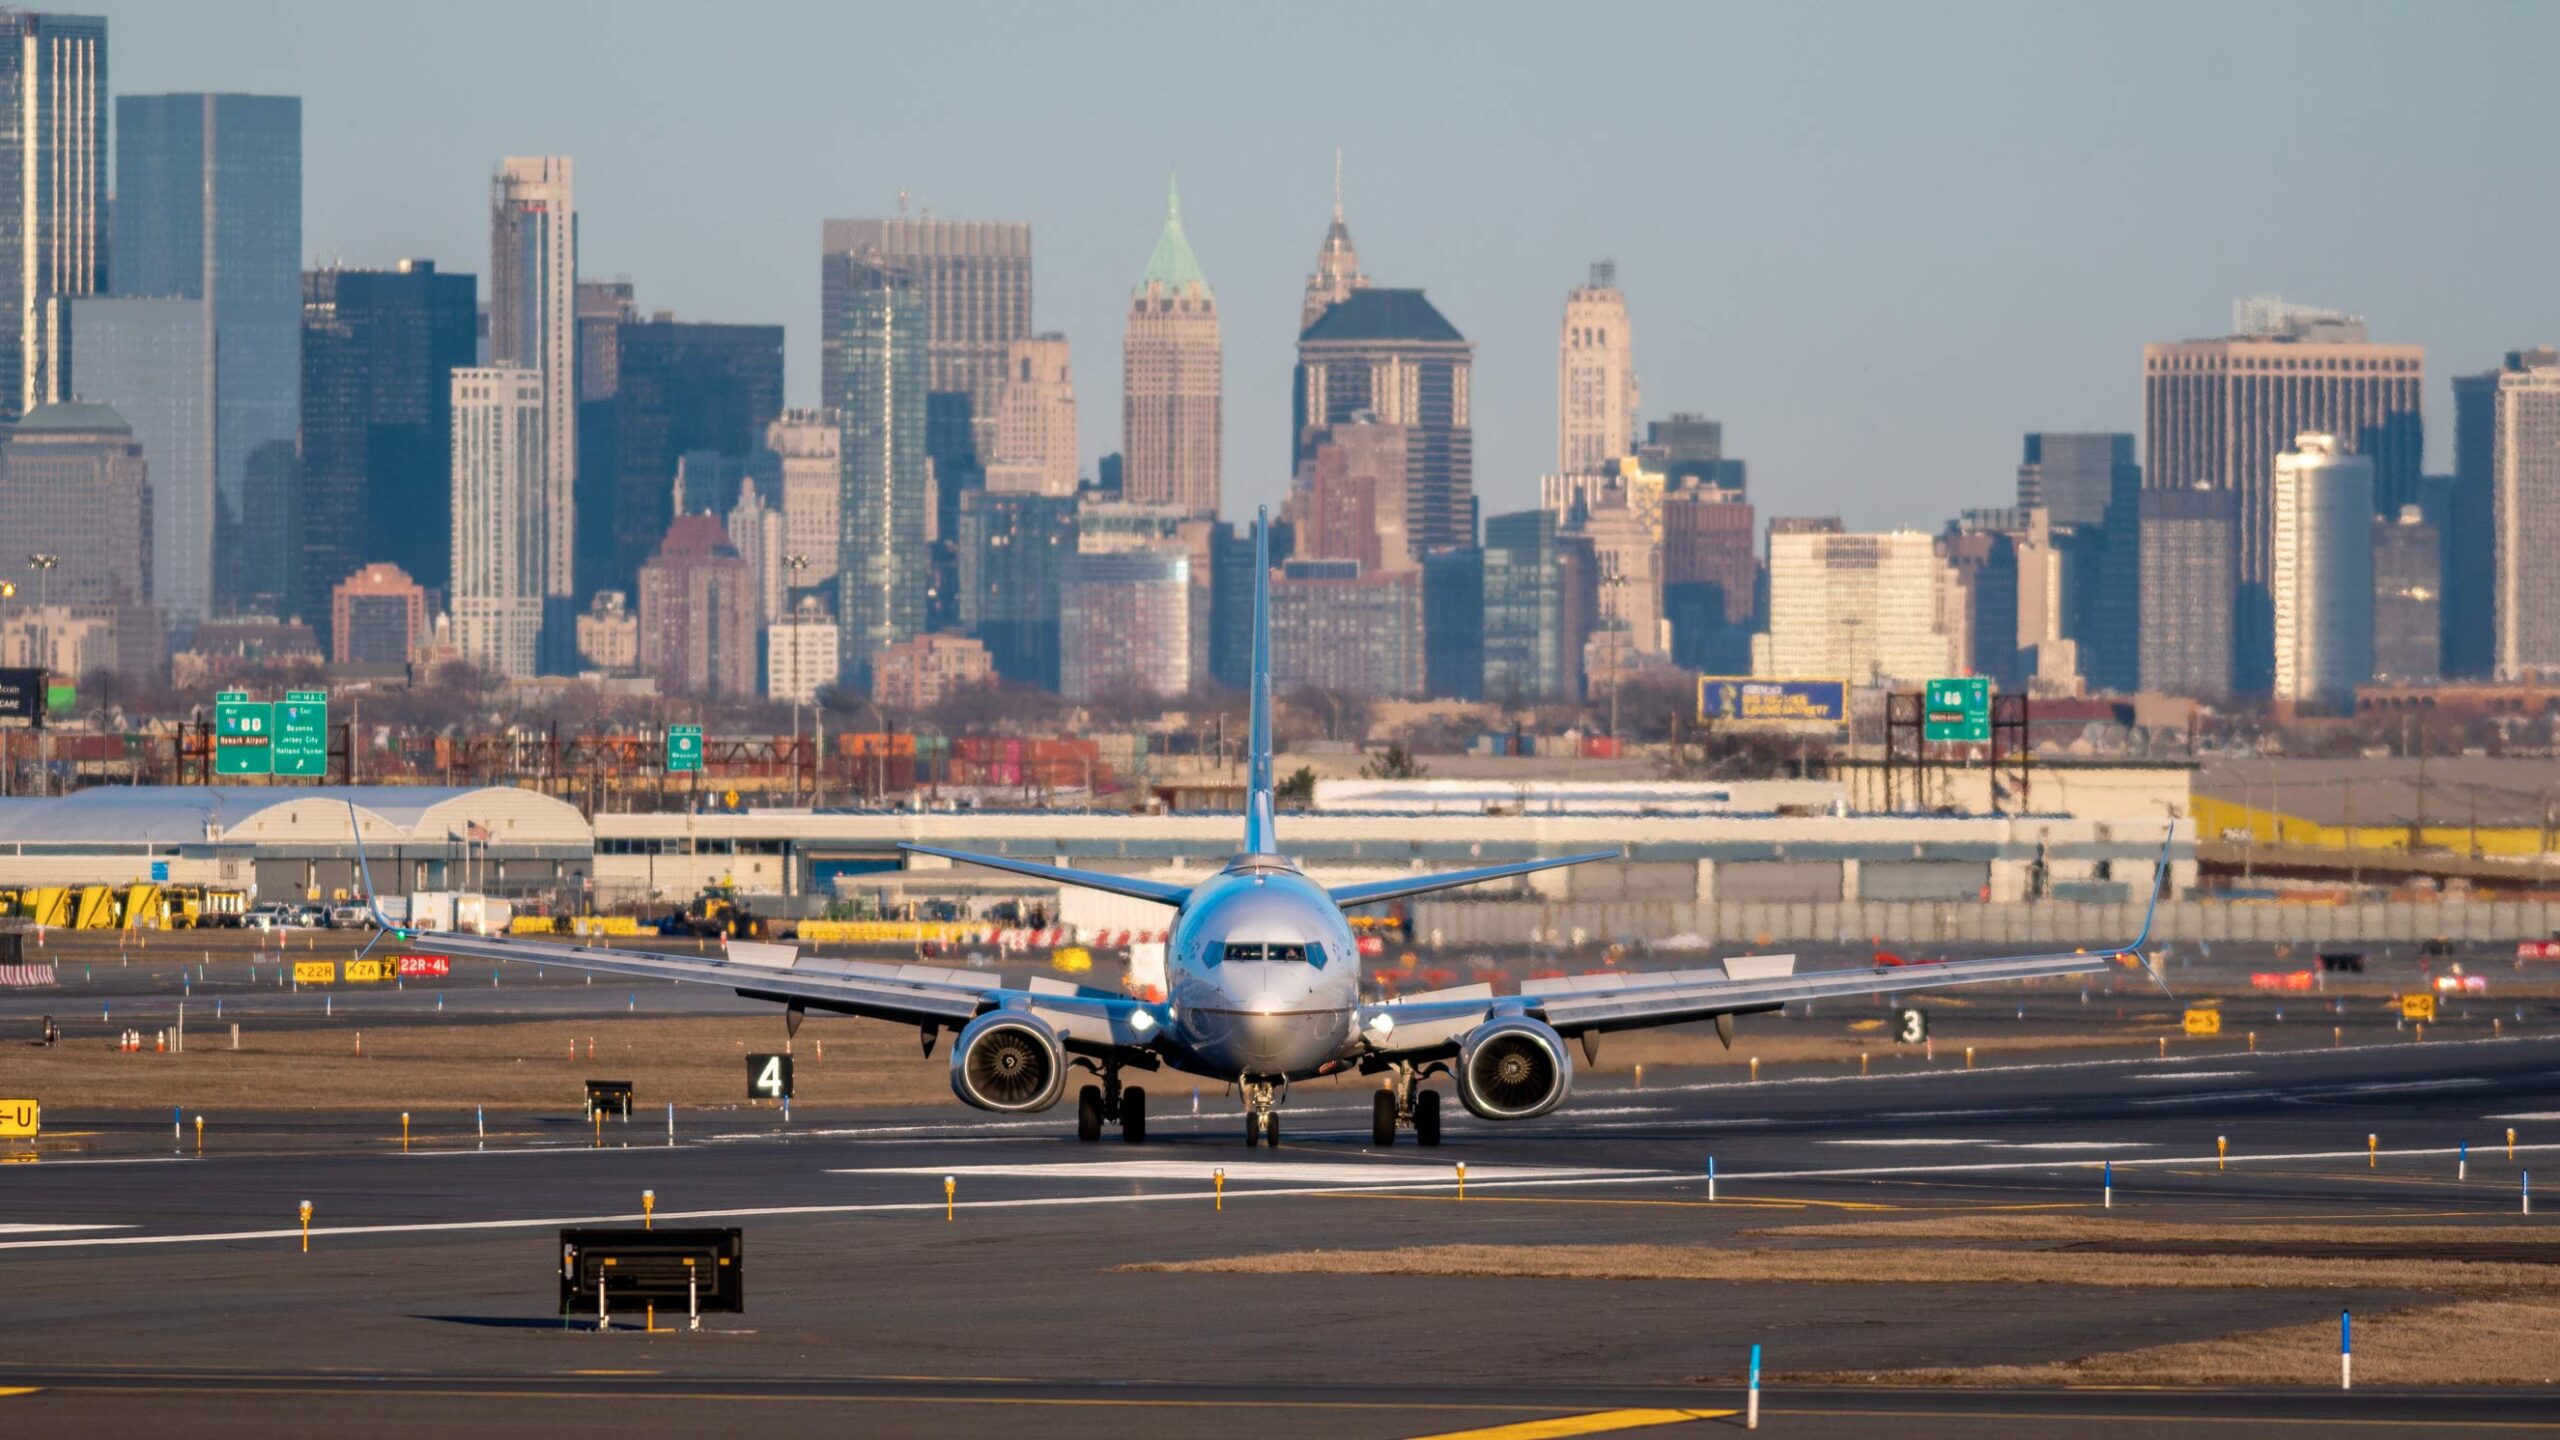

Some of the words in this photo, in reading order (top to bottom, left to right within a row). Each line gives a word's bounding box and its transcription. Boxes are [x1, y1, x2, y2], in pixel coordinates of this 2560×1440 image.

[286, 724, 314, 732] Bayonne
[220, 736, 243, 745] Newark
[245, 736, 268, 745] Airport
[305, 736, 318, 744] City
[384, 964, 392, 976] Z
[401, 959, 449, 971] 22R-4L
[307, 967, 333, 977] 22R
[1903, 1009, 1921, 1042] 3
[757, 1056, 782, 1097] 4
[17, 1106, 31, 1128] U
